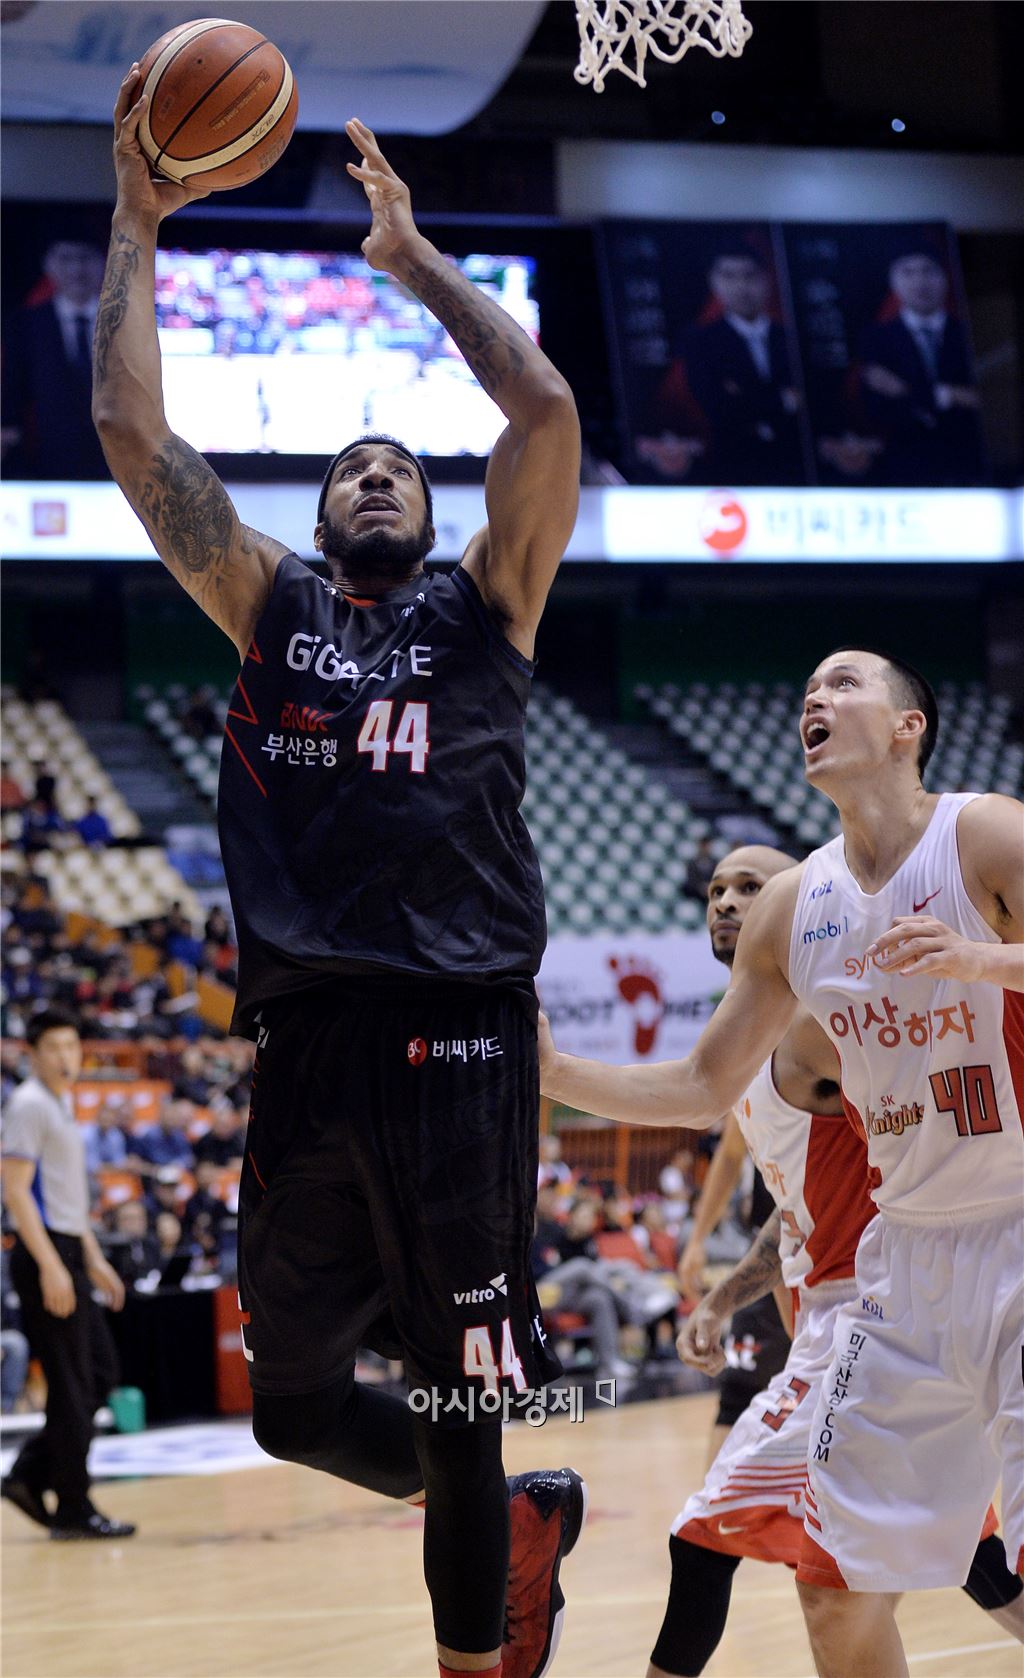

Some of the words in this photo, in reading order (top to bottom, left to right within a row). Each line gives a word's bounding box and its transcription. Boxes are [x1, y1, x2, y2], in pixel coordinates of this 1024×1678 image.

[261, 733, 338, 768] 부산은행
[357, 699, 429, 774] 44
[432, 1036, 504, 1063] 비씨카드
[880, 1094, 896, 1108] SK
[928, 1064, 1003, 1137] 40
[865, 1102, 925, 1139] Knights
[453, 1288, 496, 1305] vitro
[463, 1316, 528, 1394] 44
